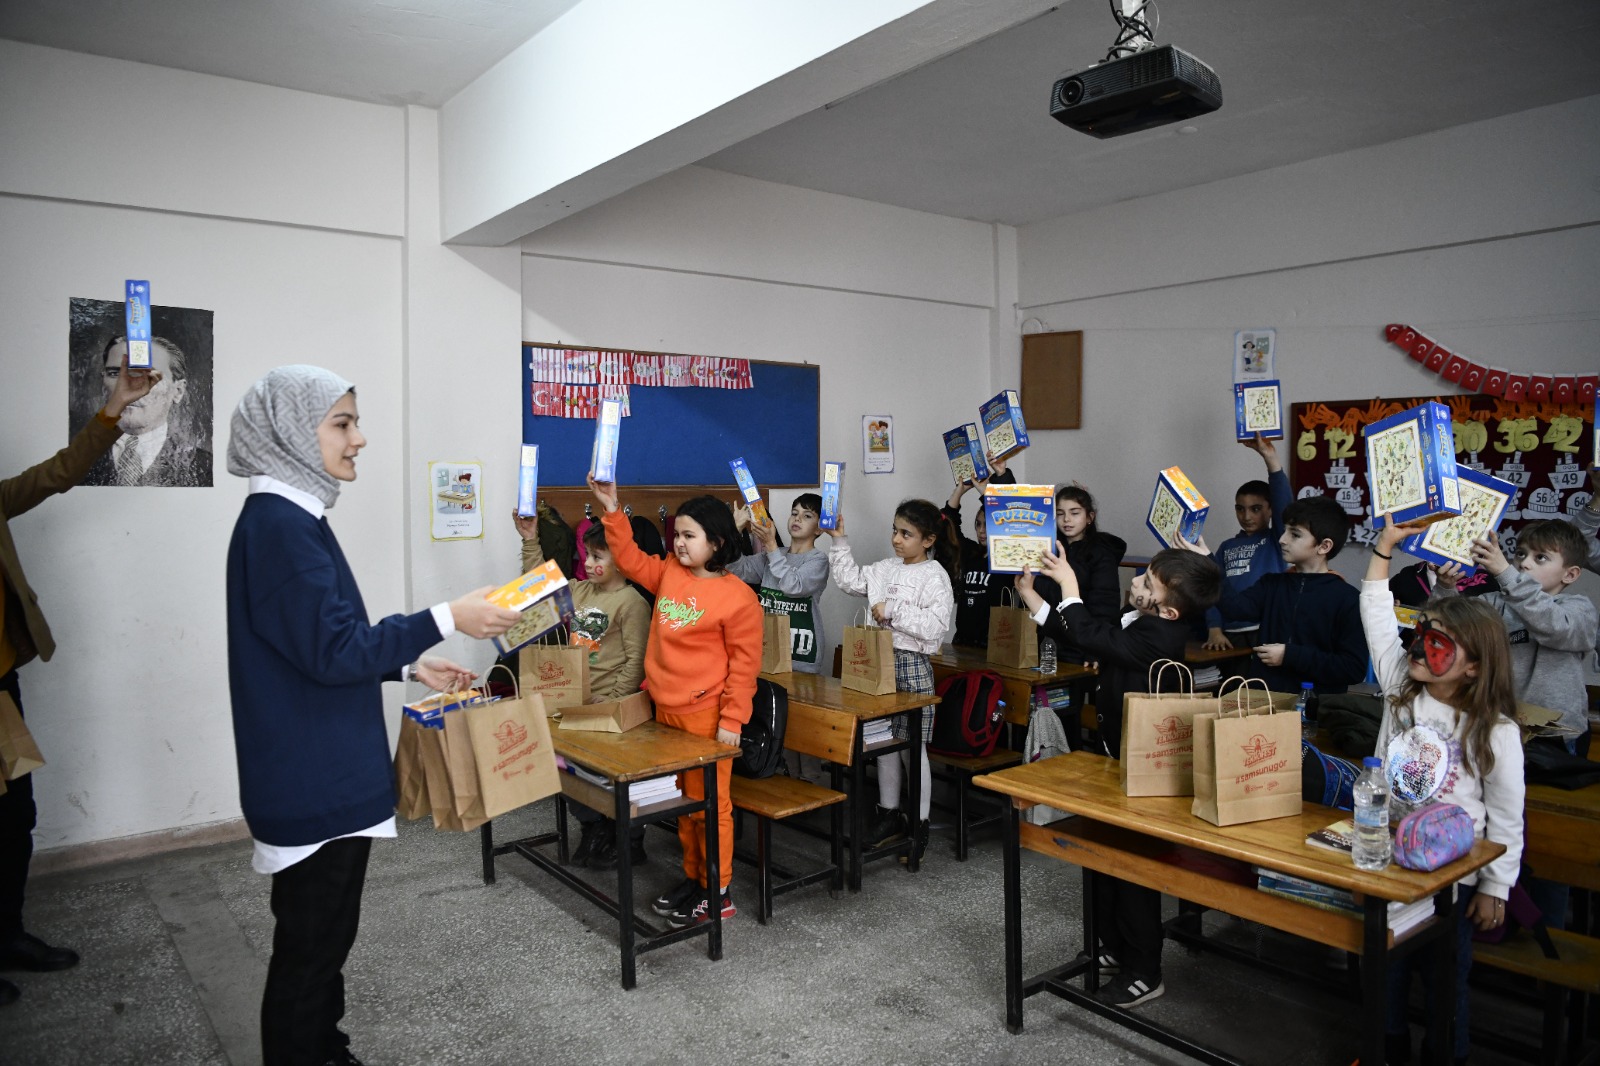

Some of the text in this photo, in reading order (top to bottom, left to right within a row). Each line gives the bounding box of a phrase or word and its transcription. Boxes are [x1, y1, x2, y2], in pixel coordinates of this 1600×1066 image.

[1494, 418, 1539, 454] 36
[1543, 416, 1583, 454] 42
[1297, 430, 1317, 461] 6
[1324, 427, 1356, 460] 12
[1334, 475, 1346, 485] 14
[1507, 472, 1523, 484] 42
[1561, 473, 1578, 485] 49
[1306, 490, 1311, 498] 8
[1342, 491, 1351, 500] 16
[1536, 492, 1547, 503] 56
[1574, 496, 1585, 507] 64
[991, 508, 1048, 526] PUZZLE
[1361, 528, 1379, 541] 27
[774, 600, 808, 612] TYPEFACE
[1145, 745, 1193, 760] #samsunug
